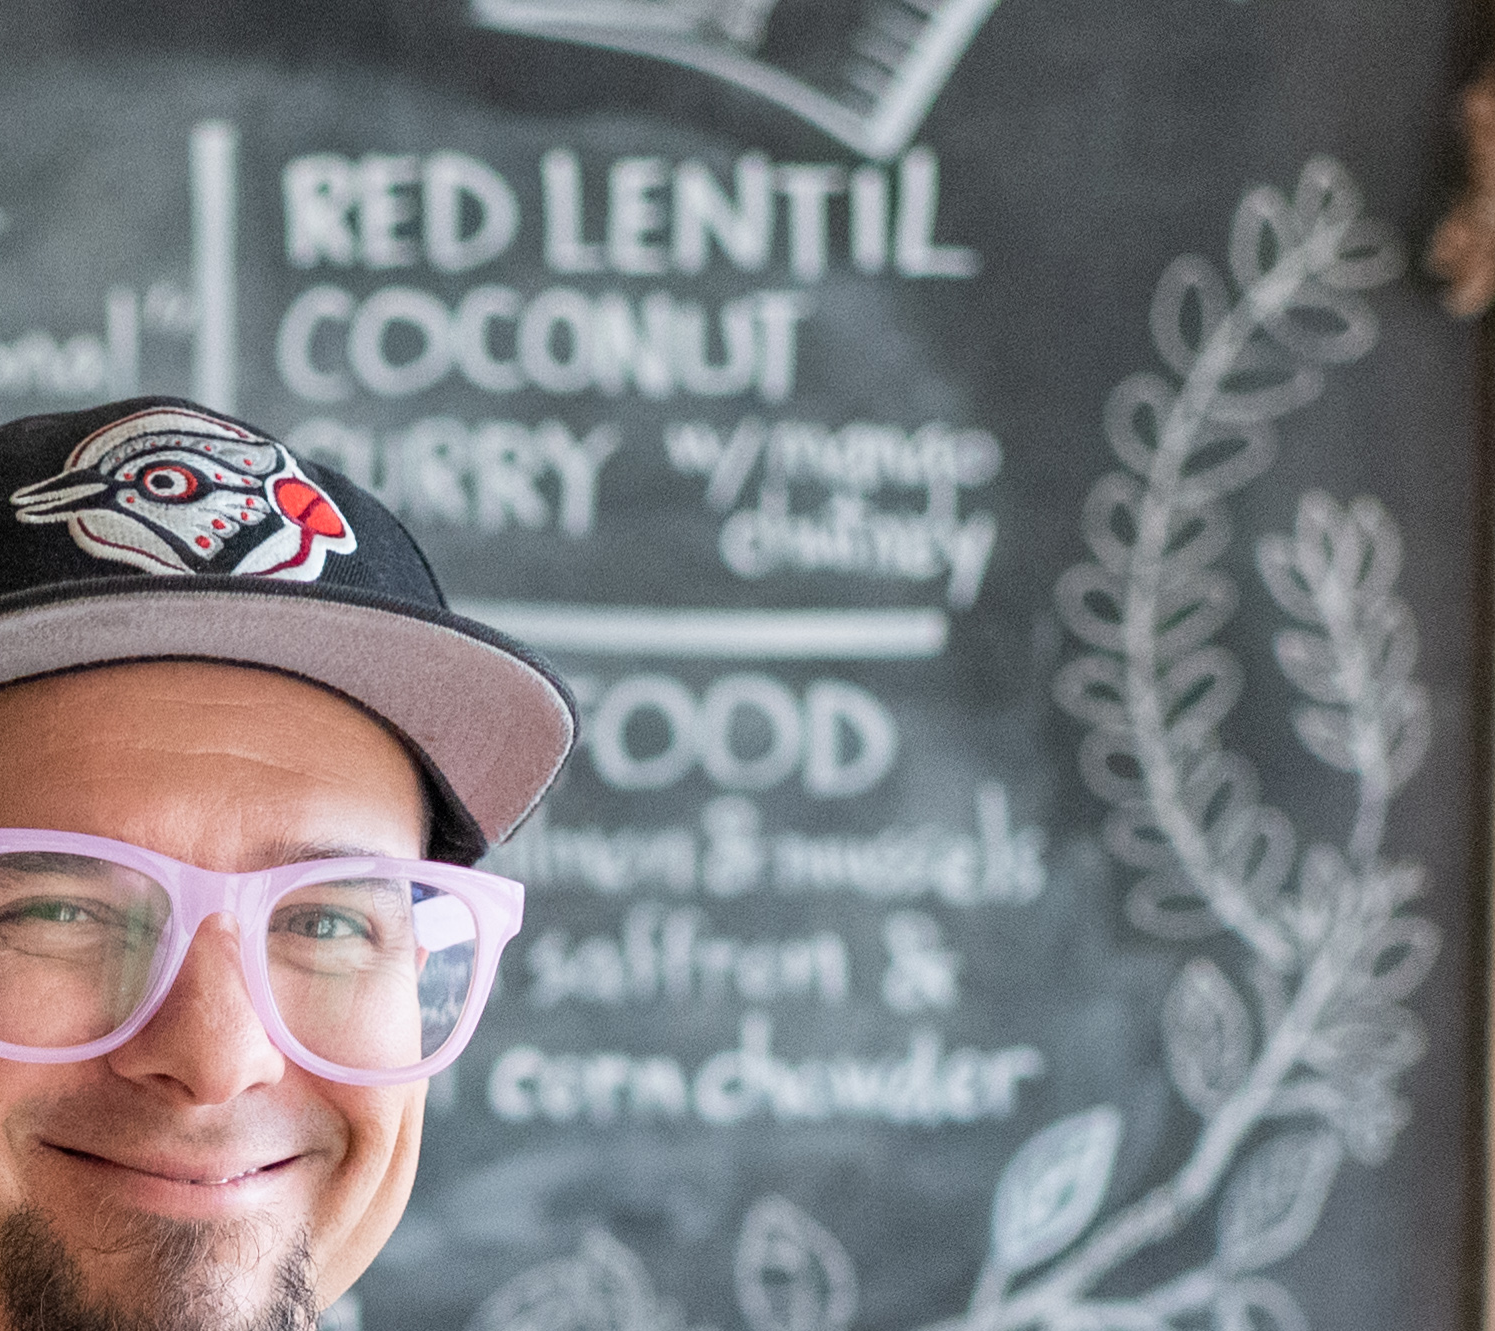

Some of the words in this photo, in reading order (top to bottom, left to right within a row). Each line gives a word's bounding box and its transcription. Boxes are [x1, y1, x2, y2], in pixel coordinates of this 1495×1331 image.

[281, 150, 520, 275] RED
[539, 145, 984, 285] LENTIL
[276, 283, 814, 404] COCONUT
[881, 909, 965, 1015] &
